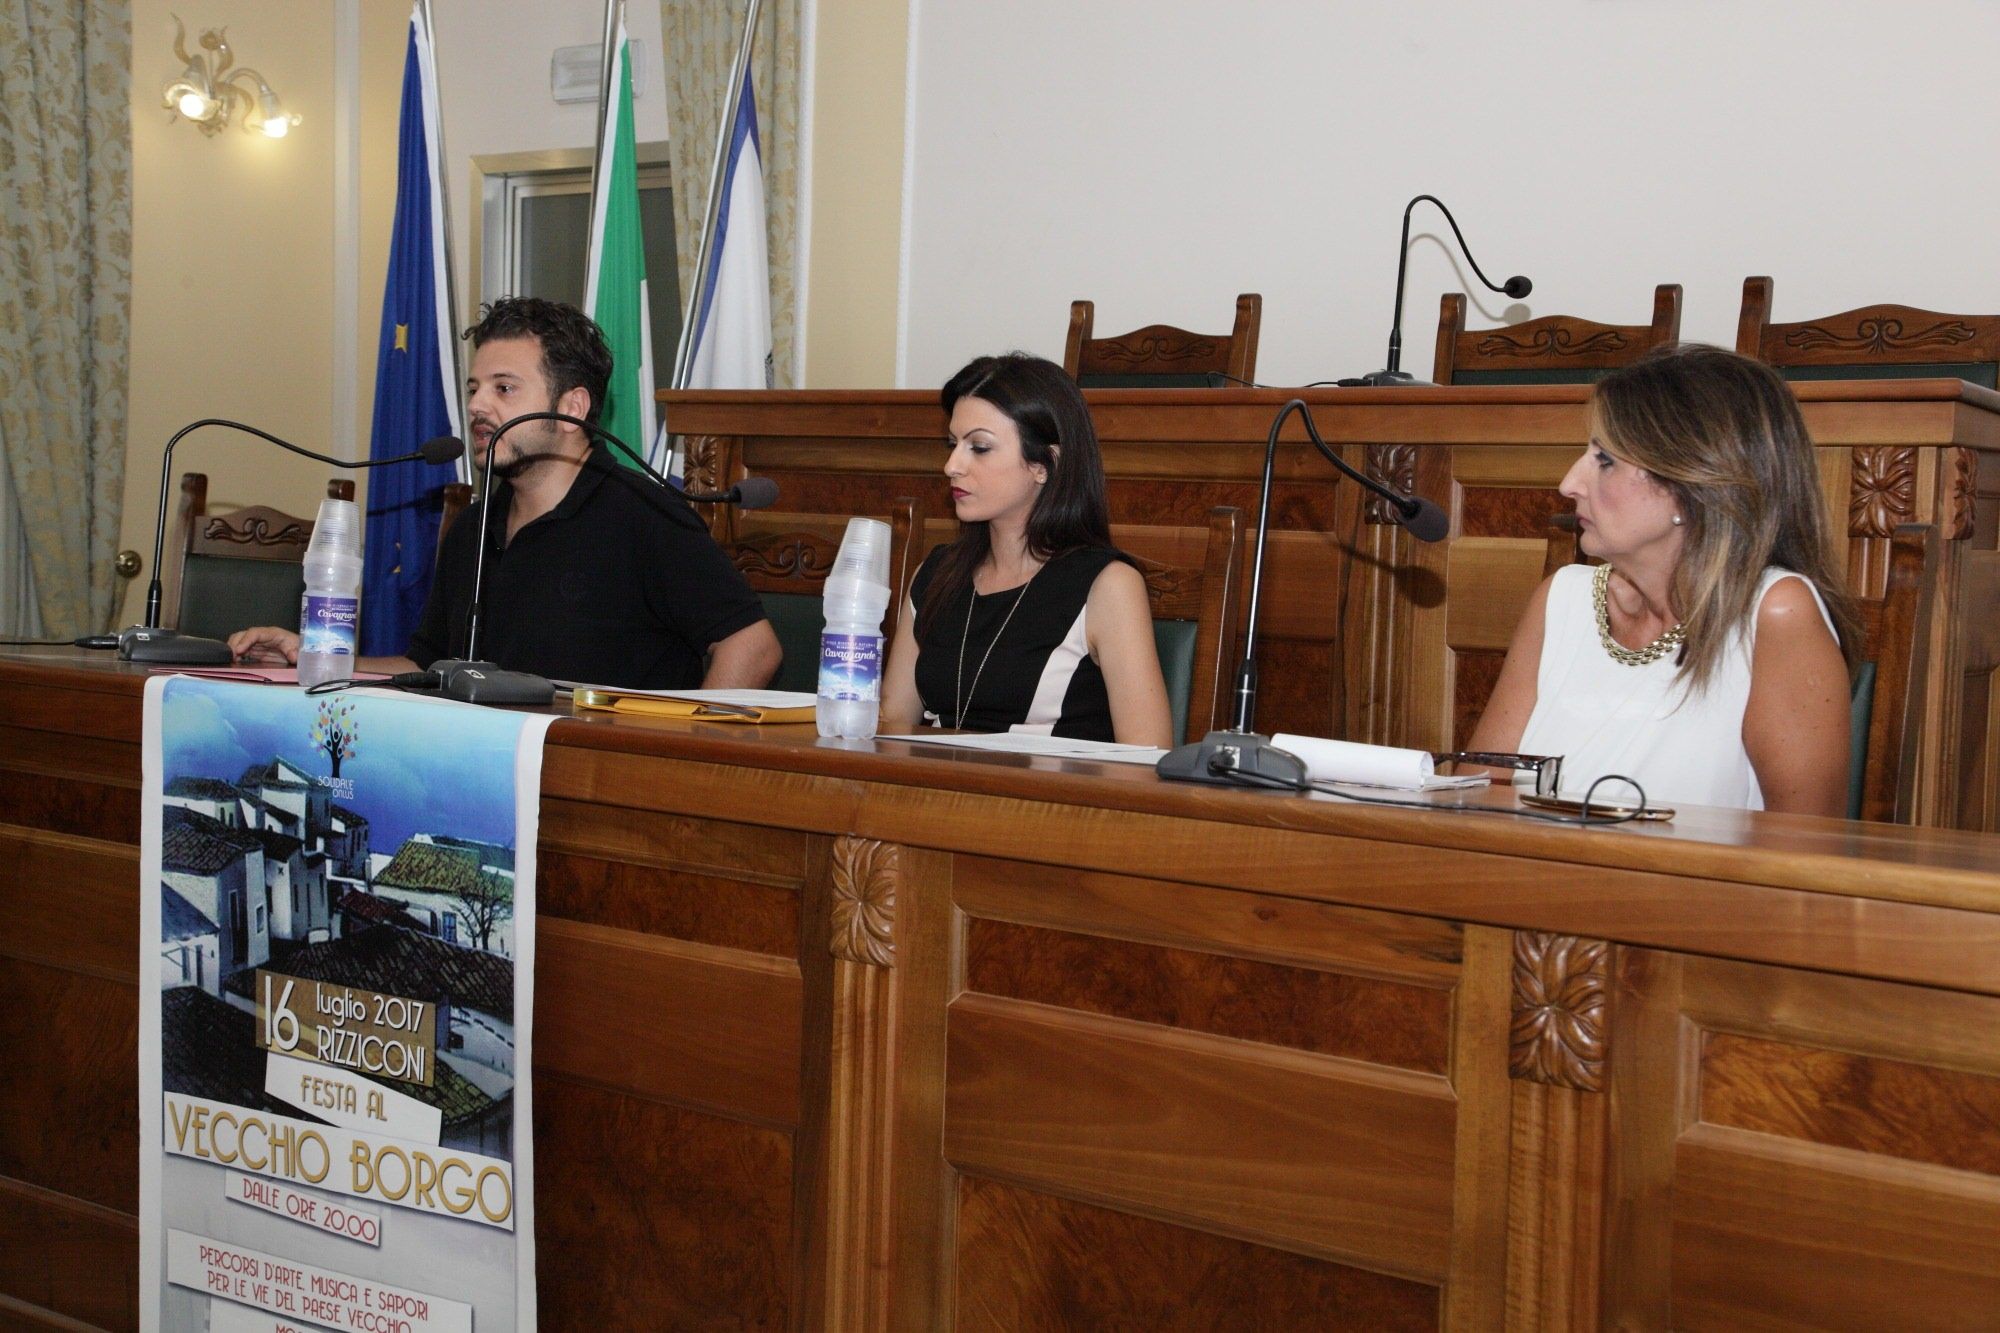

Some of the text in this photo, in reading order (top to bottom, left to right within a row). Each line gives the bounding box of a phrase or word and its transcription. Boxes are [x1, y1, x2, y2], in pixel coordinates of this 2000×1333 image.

[265, 975, 299, 1050] 16
[316, 982, 424, 1033] luglio 2017
[316, 1024, 425, 1082] RIZZICONI
[301, 1075, 388, 1122] FESTA AL
[168, 1100, 512, 1223] VECCHIO BORGO
[243, 1178, 376, 1241] DALLE ORE 20.00
[199, 1245, 258, 1277] PERCORSI
[311, 1274, 358, 1304] MUSICA
[364, 1288, 372, 1307] E
[378, 1291, 428, 1321] SAPORI
[207, 1270, 411, 1333] PER LE VIE DEL PAESE VECCHIO
